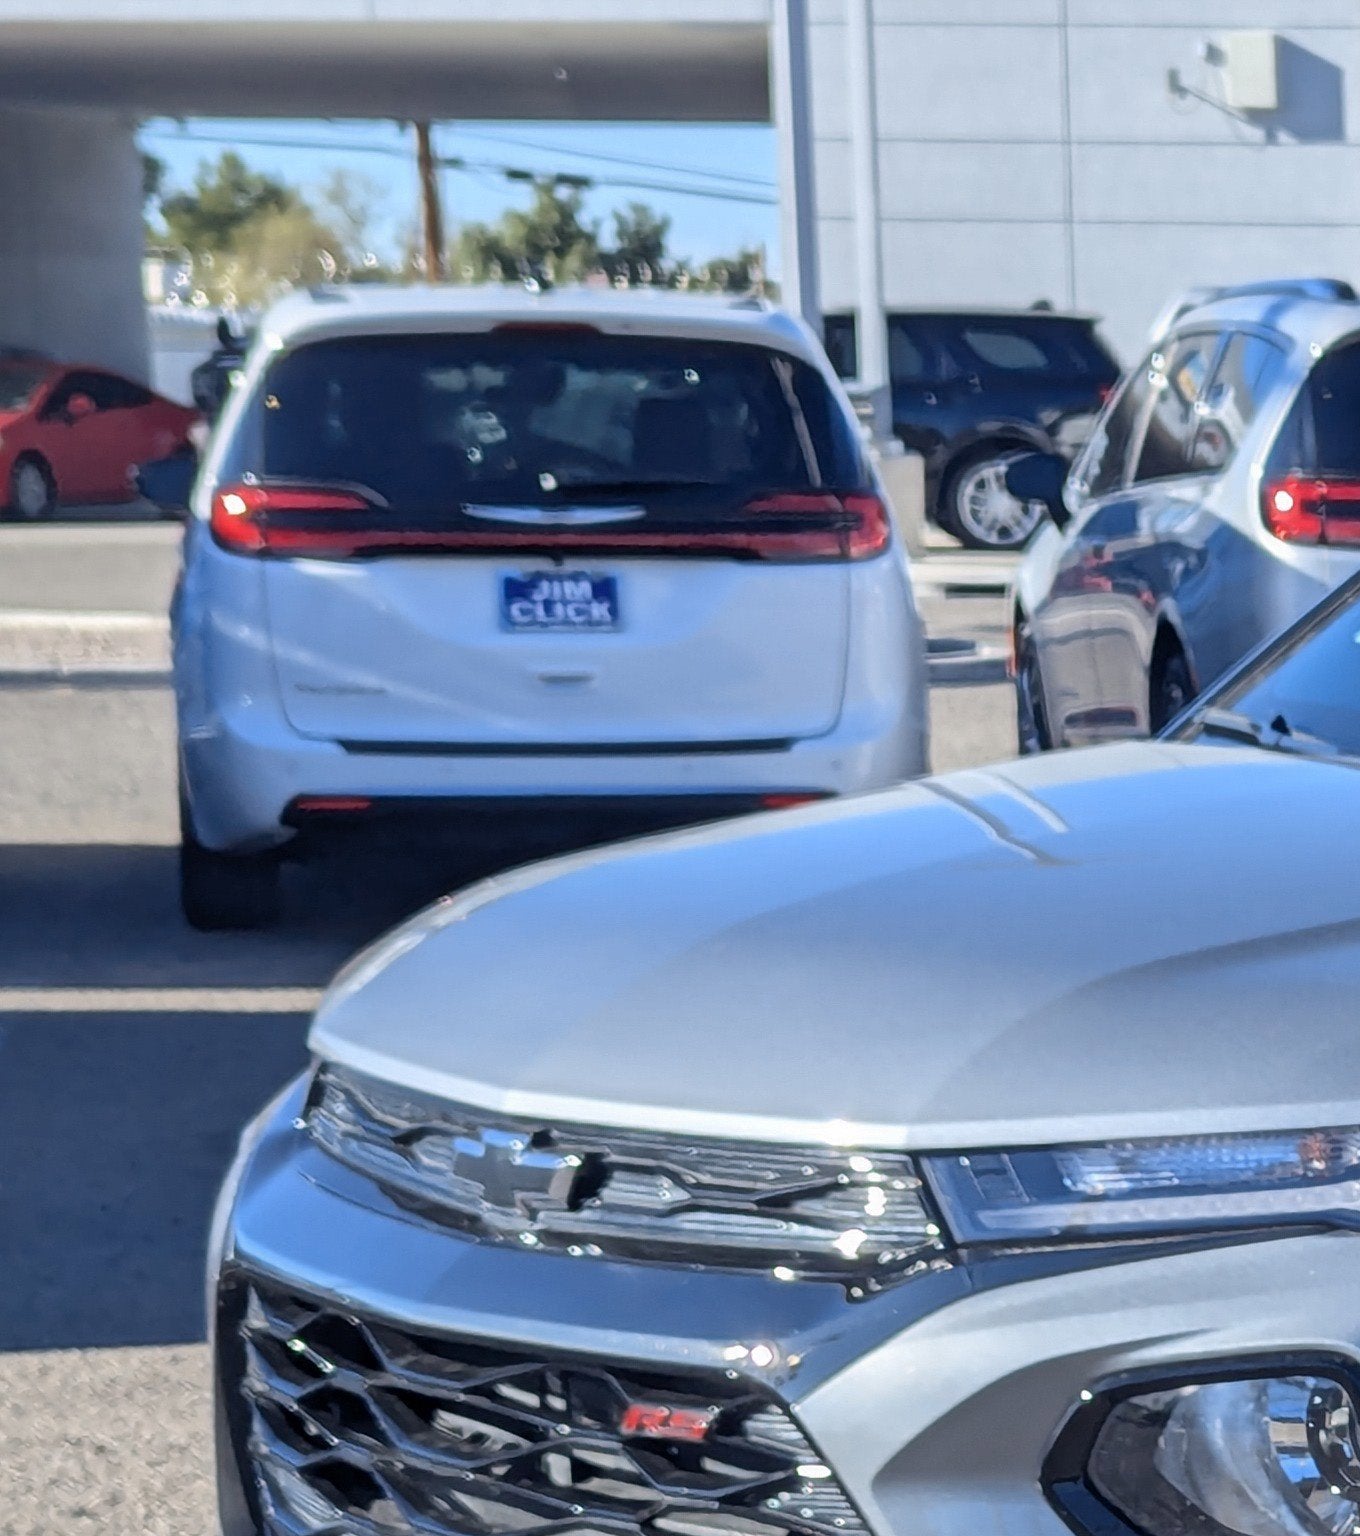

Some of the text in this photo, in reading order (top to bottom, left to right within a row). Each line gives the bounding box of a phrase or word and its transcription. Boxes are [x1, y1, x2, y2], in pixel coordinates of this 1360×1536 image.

[531, 579, 592, 601] JIM
[509, 600, 612, 623] CLICK
[621, 1403, 706, 1440] RS
